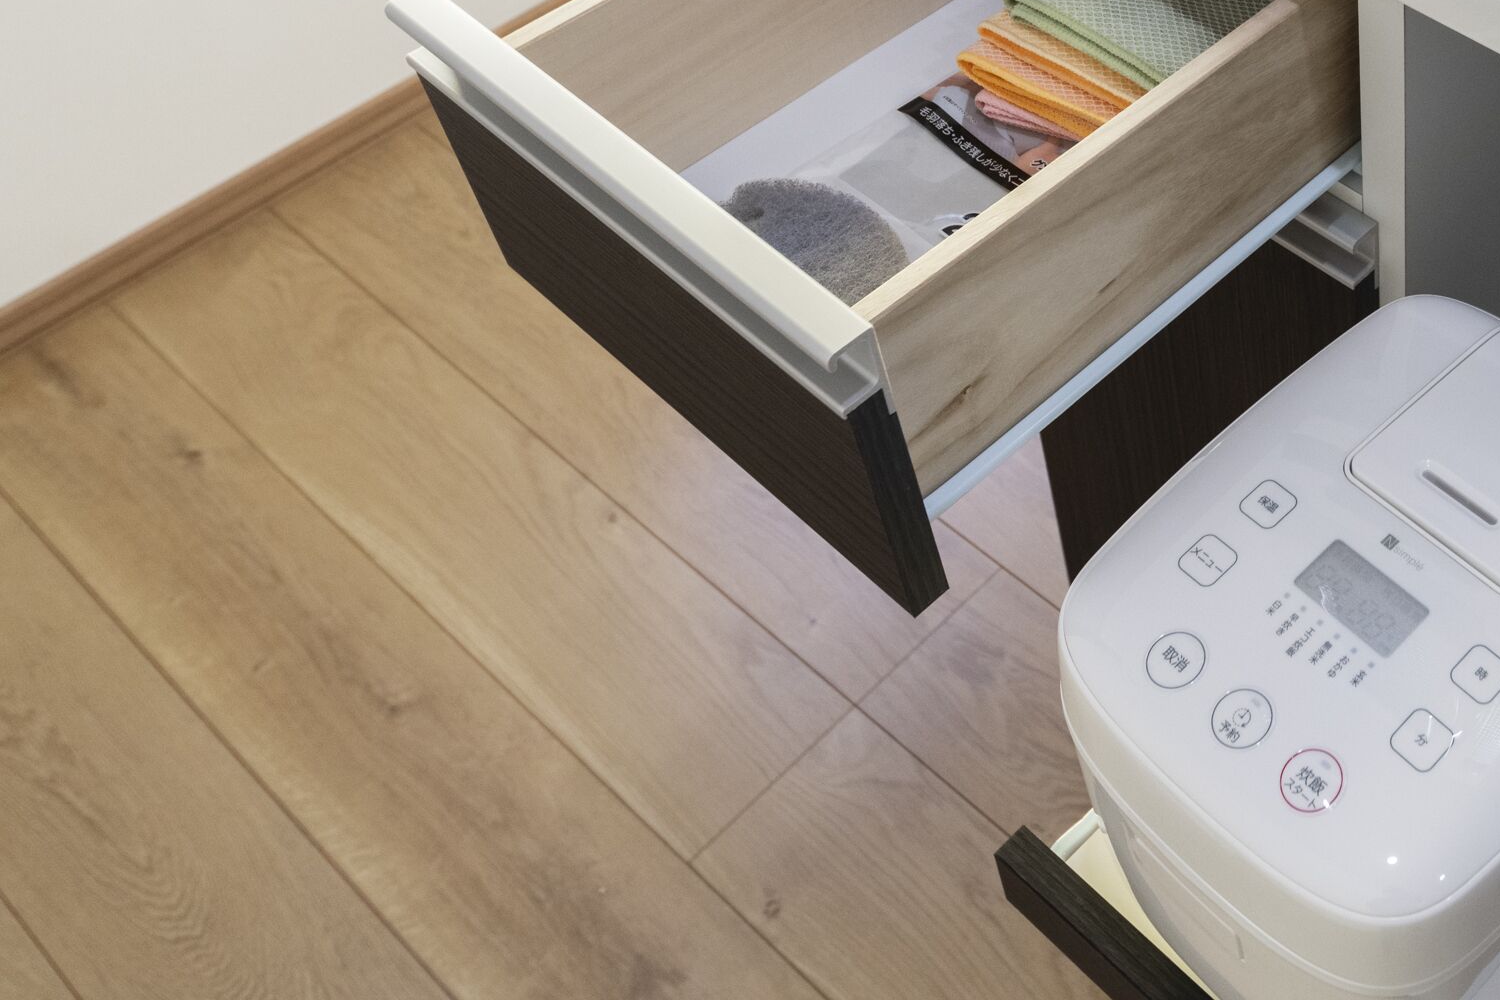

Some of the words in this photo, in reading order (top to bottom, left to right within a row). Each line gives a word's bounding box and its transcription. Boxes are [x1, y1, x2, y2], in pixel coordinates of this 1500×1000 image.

[1162, 645, 1190, 673] 取消
[1218, 720, 1240, 743] 予約
[1284, 777, 1317, 808] スタート
[1296, 766, 1328, 797] 炊飯
